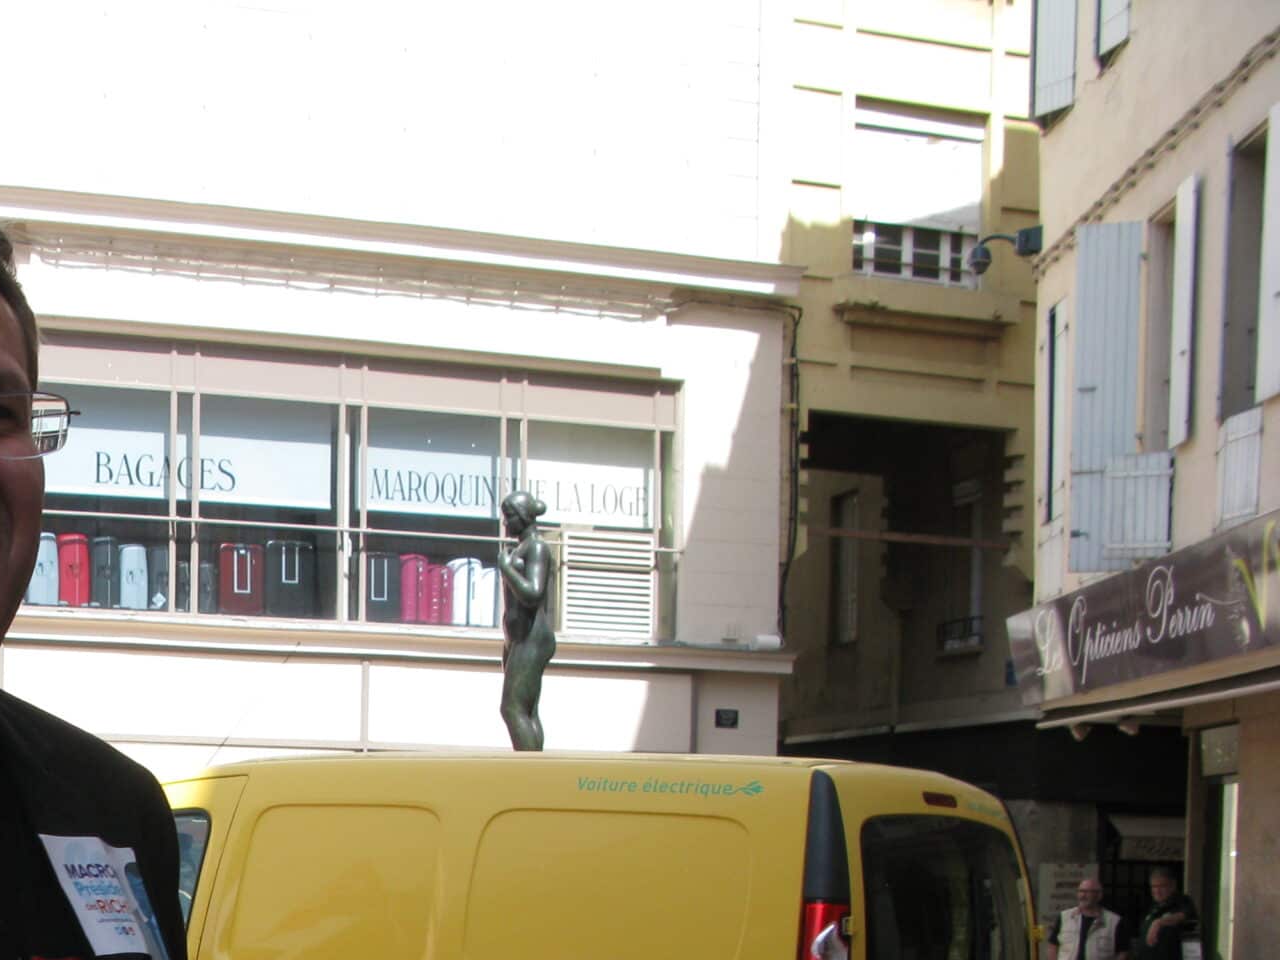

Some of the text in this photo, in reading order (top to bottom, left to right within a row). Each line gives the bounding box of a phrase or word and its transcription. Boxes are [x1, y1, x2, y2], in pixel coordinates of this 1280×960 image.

[95, 451, 237, 492] BAGAGES
[556, 481, 583, 514] LA
[589, 483, 648, 518] LOGE
[1068, 595, 1141, 685] Opticiens
[1146, 565, 1217, 643] Perrin
[577, 776, 734, 797] Voiture électrique
[63, 863, 119, 879] MACRO
